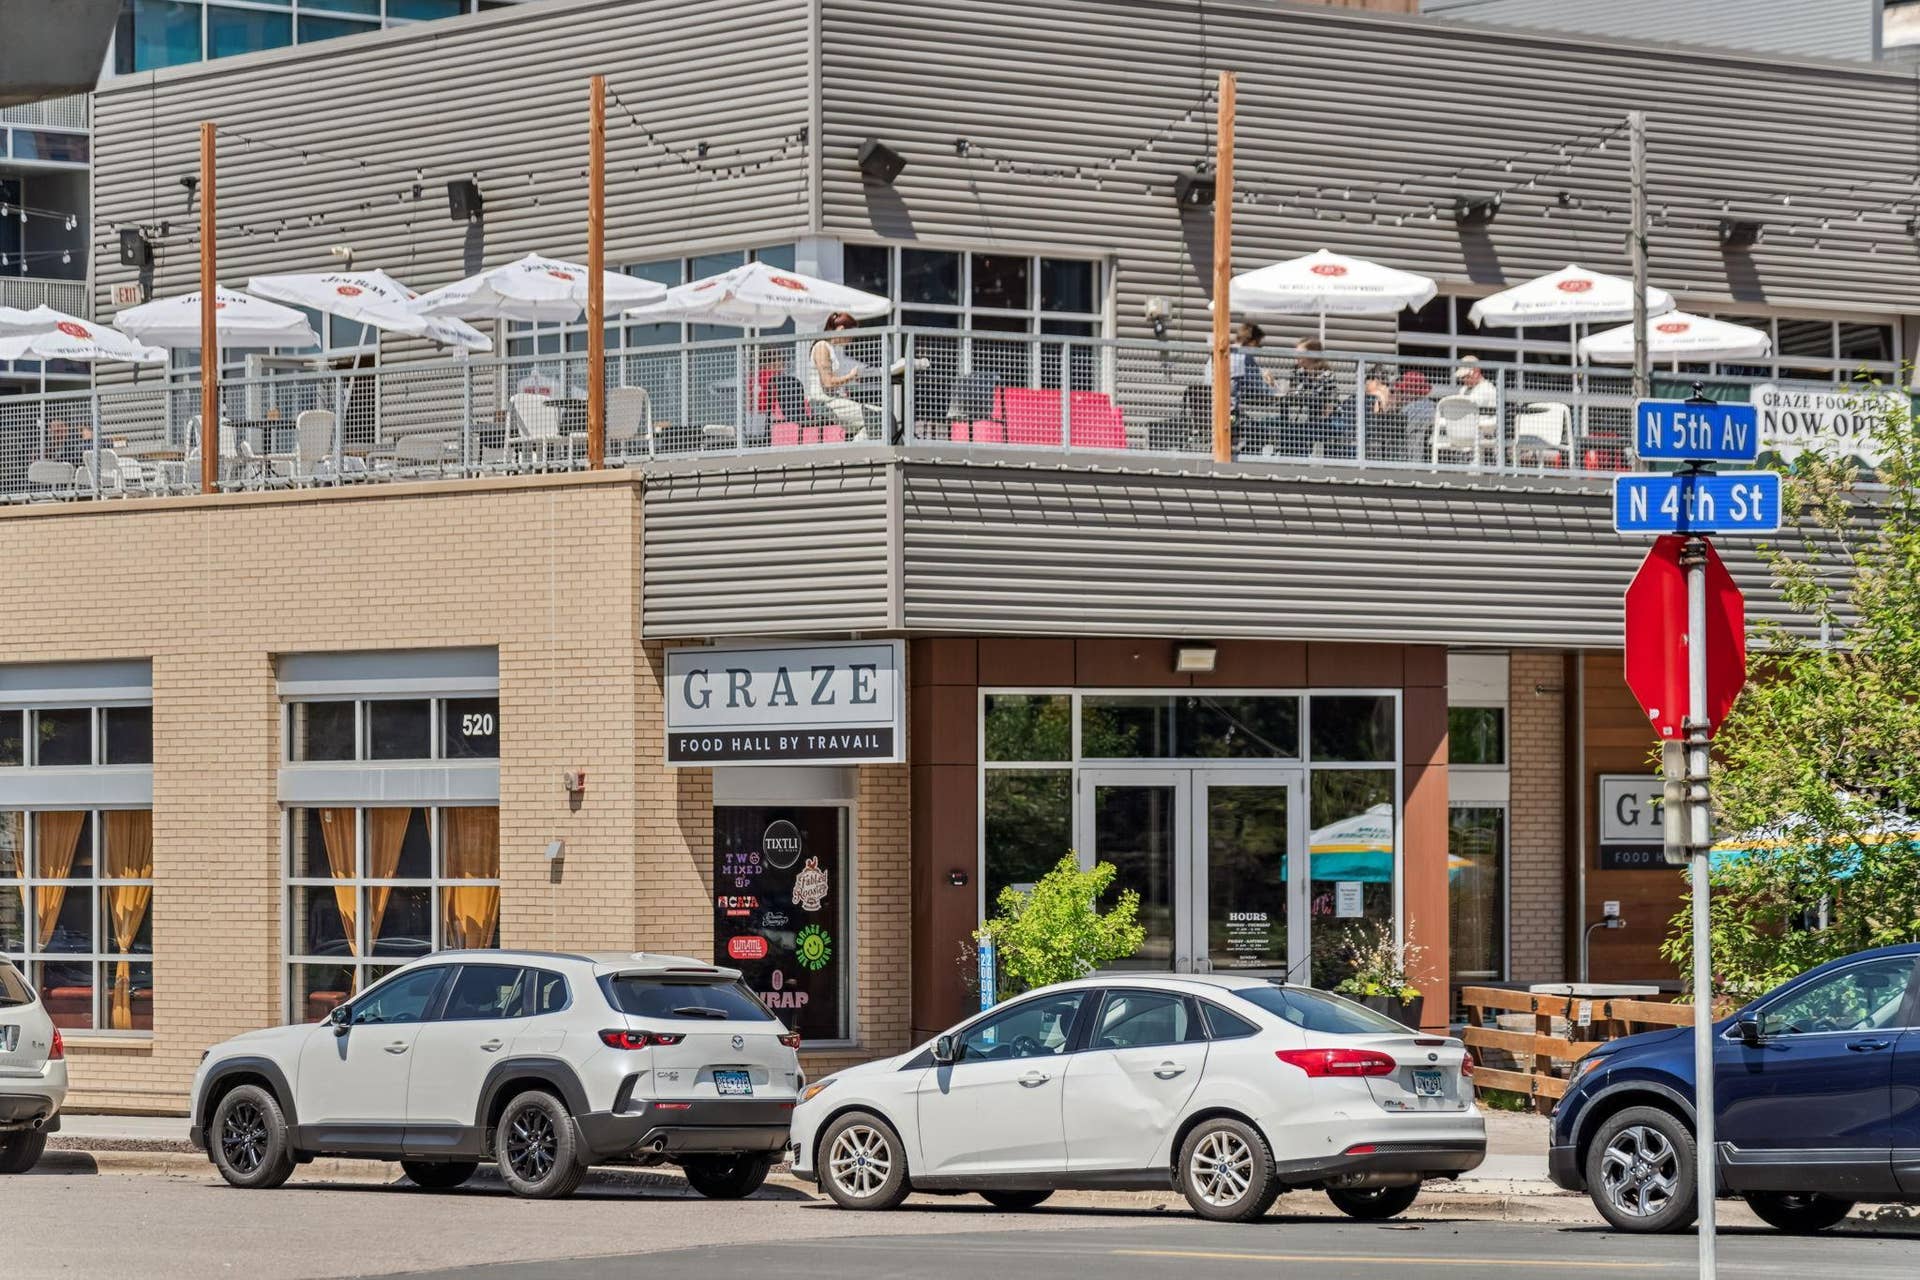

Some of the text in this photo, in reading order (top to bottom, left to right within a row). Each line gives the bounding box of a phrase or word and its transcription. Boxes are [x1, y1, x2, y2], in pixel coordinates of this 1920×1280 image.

[118, 286, 137, 302] EXIT
[1762, 391, 1811, 410] GRAZE
[1647, 412, 1748, 450] N 5th Av
[1763, 410, 1823, 435] NOW
[1630, 483, 1763, 522] N 4th St
[683, 663, 877, 709] GRAZE
[462, 713, 493, 736] 520
[680, 734, 879, 752] FOOD HALL BY TRAVAIL
[765, 838, 798, 849] TIXTLI
[1615, 852, 1650, 863] FOOD
[722, 866, 762, 874] MIXED
[735, 877, 751, 887] UP
[1229, 912, 1268, 921] HOURS
